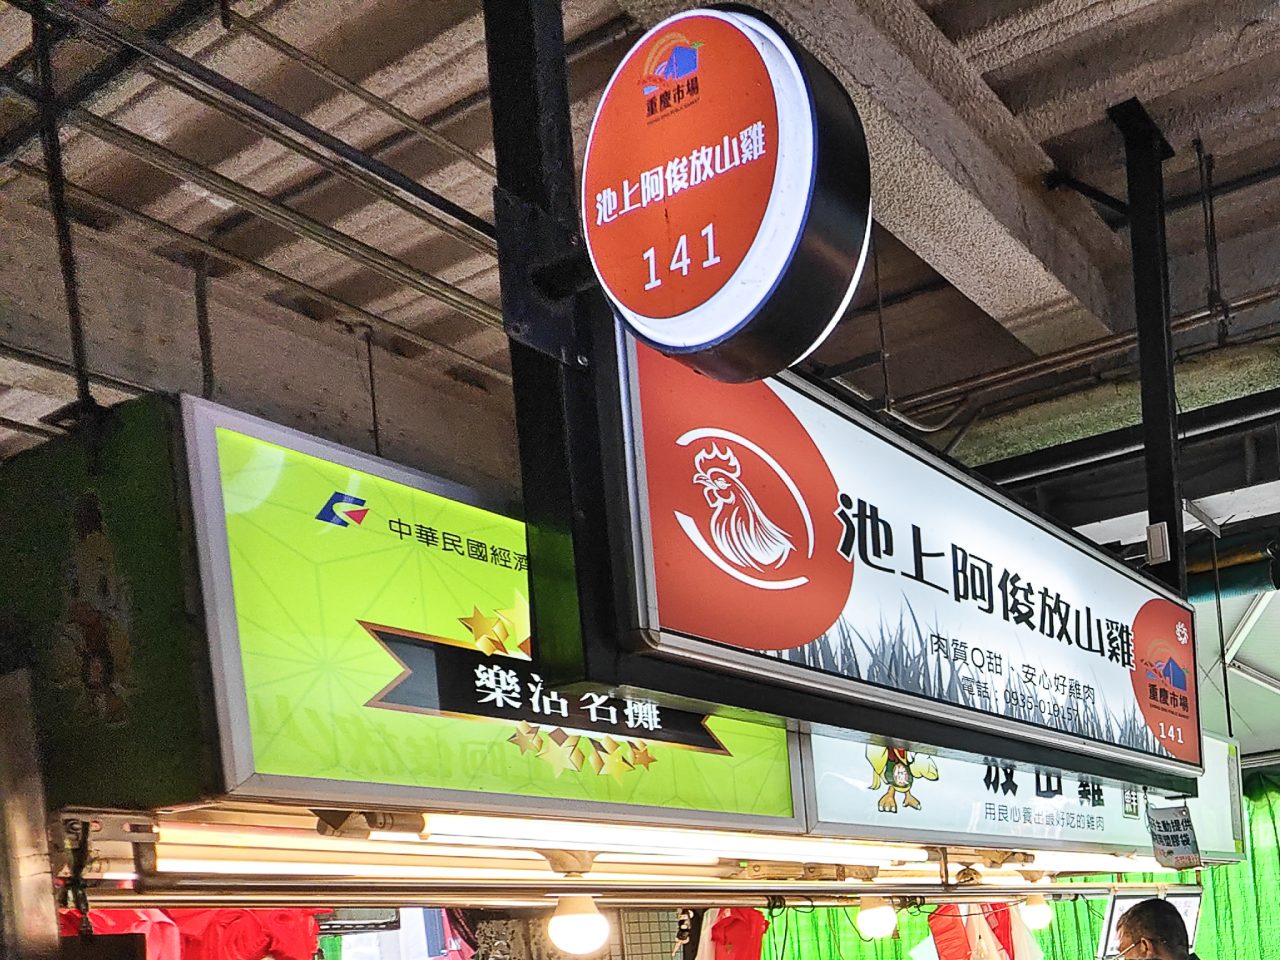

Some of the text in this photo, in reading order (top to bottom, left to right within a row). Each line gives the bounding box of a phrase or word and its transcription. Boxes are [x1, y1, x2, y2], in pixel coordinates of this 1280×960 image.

[645, 77, 700, 118] 重慶市場
[595, 120, 767, 227] 池上阿俊放山雞
[642, 222, 721, 291] 141
[839, 492, 1135, 669] 池上阿俊放山雞
[1148, 683, 1190, 712] 重慶市場
[1158, 721, 1184, 745] 141
